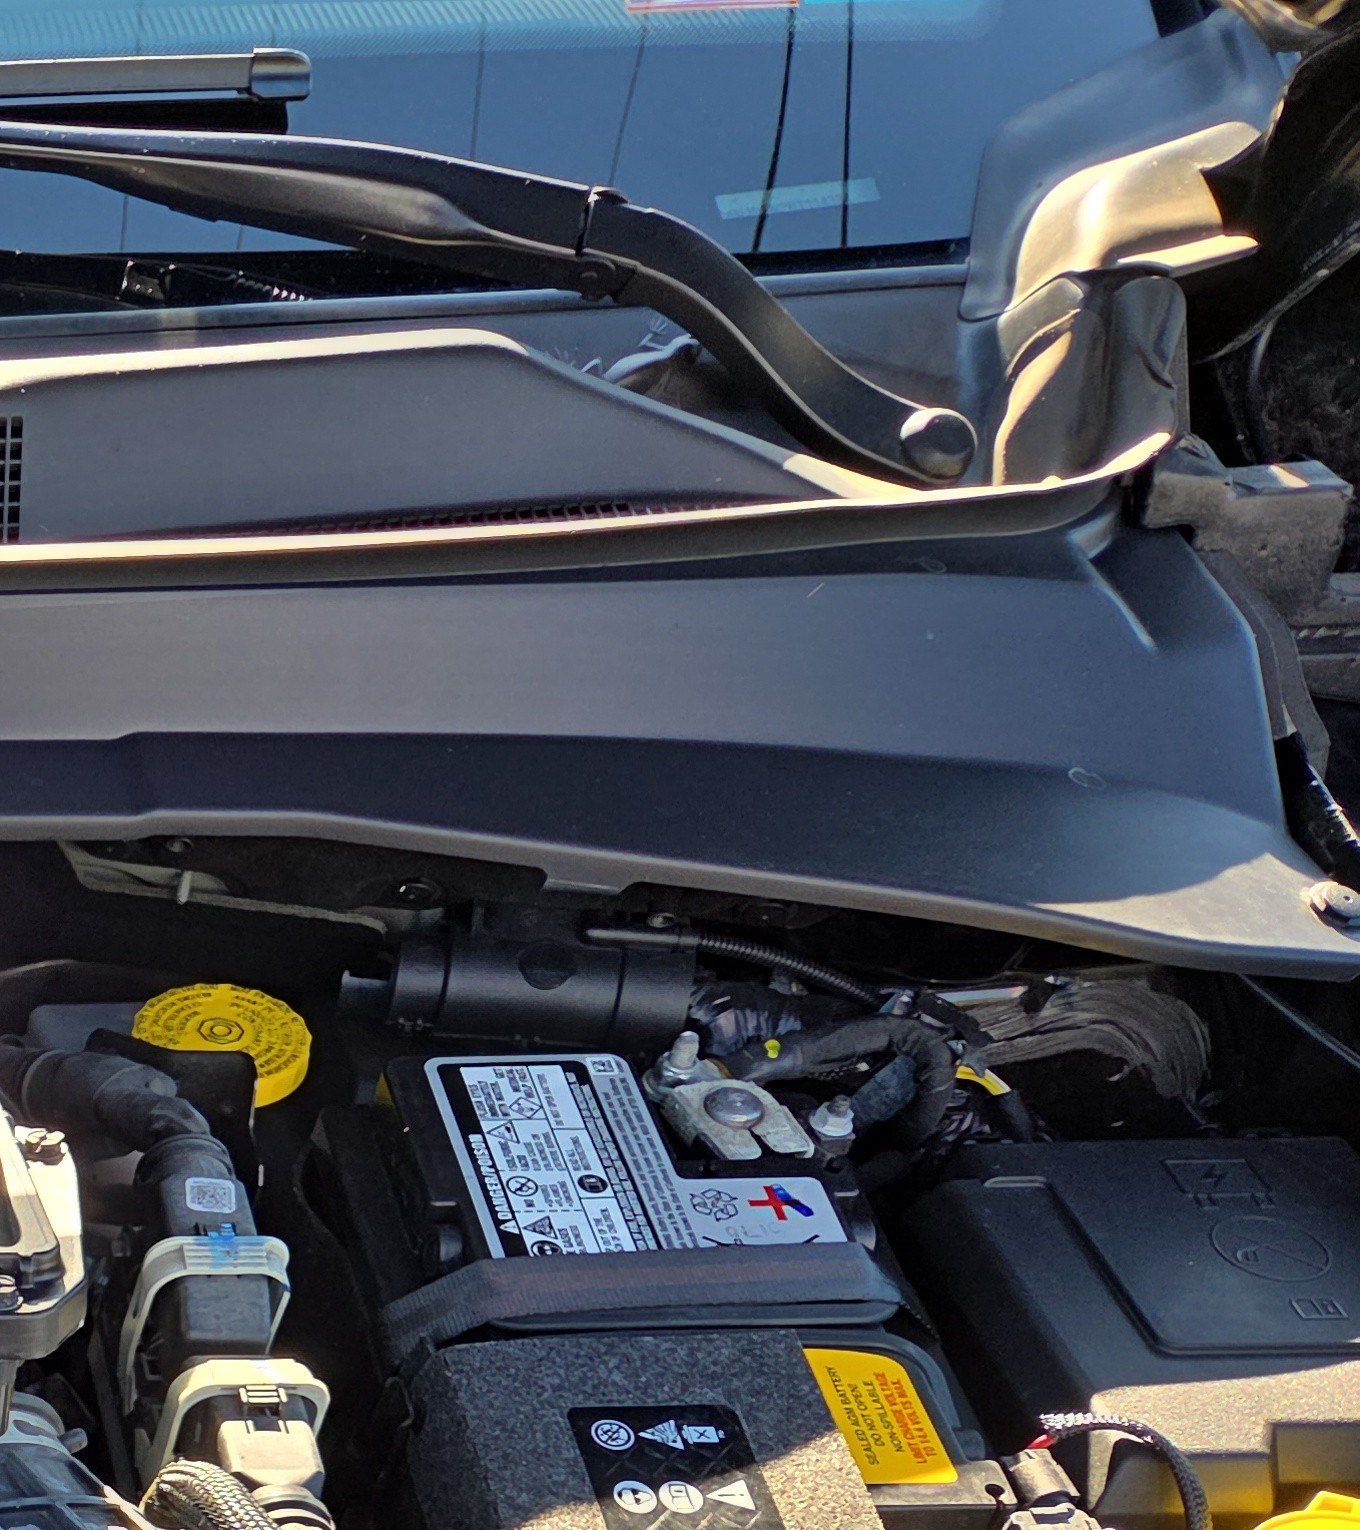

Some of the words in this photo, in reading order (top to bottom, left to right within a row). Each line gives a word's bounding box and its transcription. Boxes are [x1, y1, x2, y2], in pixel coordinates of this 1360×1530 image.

[825, 1366, 851, 1405] BATTERY
[861, 1413, 877, 1431] NOT
[862, 1380, 904, 1452] NON-SPILLABLE
[853, 1429, 879, 1465] SEALED
[870, 1433, 885, 1447] DO
